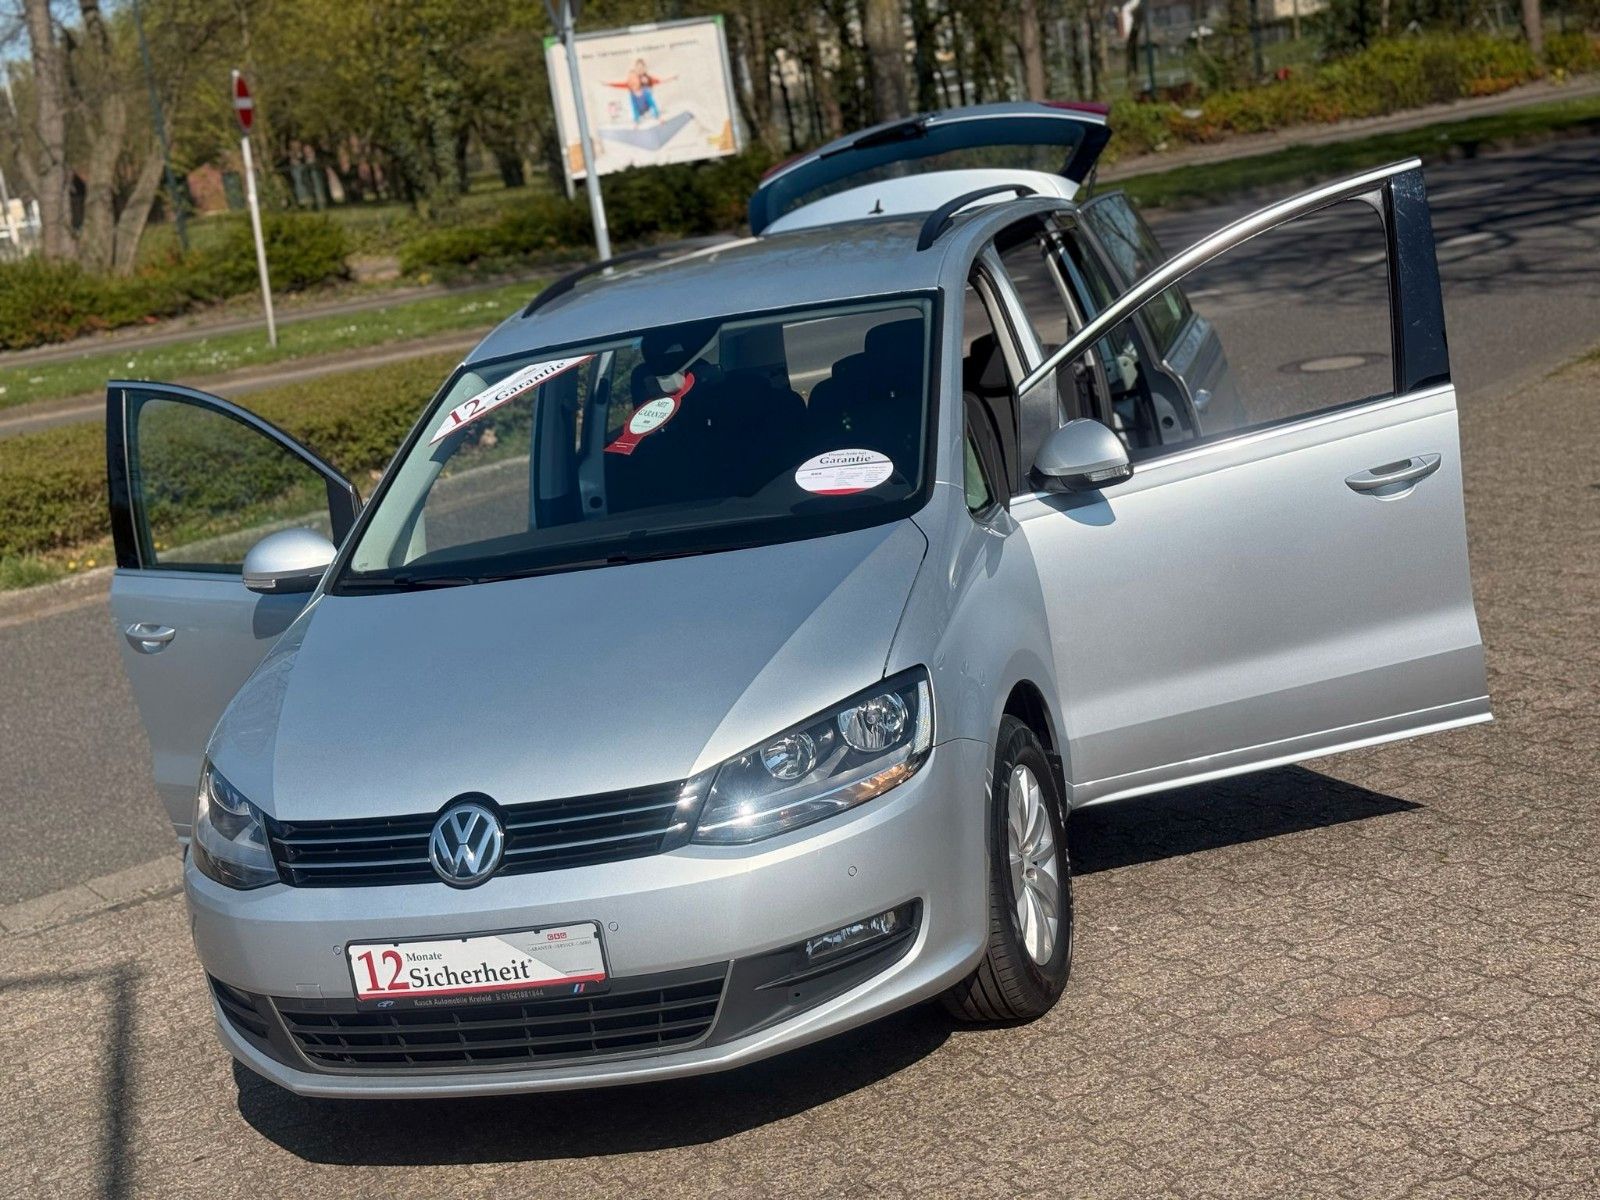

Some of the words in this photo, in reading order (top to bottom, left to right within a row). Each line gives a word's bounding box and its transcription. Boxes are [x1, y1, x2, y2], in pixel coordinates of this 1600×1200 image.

[449, 399, 486, 425] 12
[495, 361, 565, 401] Garantie
[357, 949, 410, 992] 12
[406, 951, 443, 963] Monate
